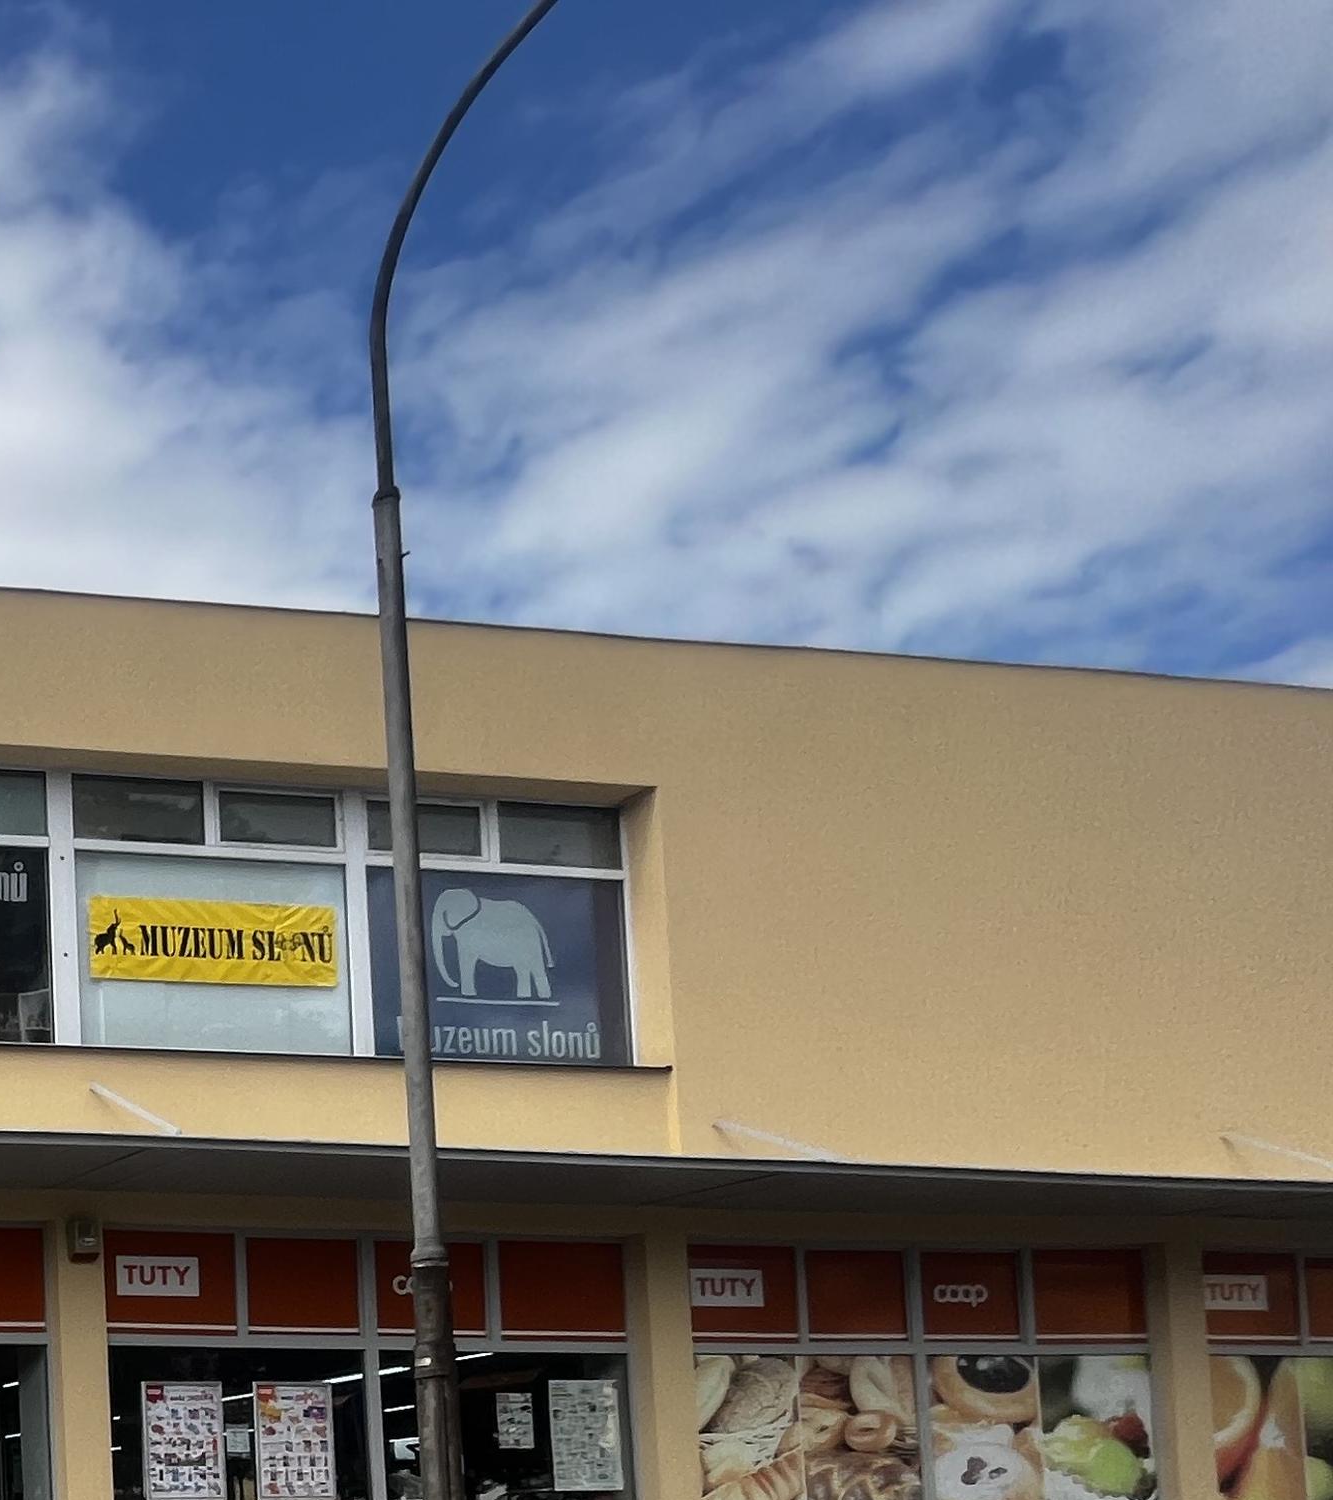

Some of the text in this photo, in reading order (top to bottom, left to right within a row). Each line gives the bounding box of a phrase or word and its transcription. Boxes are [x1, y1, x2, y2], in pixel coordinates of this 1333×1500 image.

[139, 924, 245, 960] MUZEUM
[527, 1020, 601, 1059] slonů
[123, 1264, 191, 1287] TUTY
[694, 1276, 757, 1299] TUTY
[934, 1283, 988, 1307] coop
[1206, 1283, 1261, 1302] TUTY
